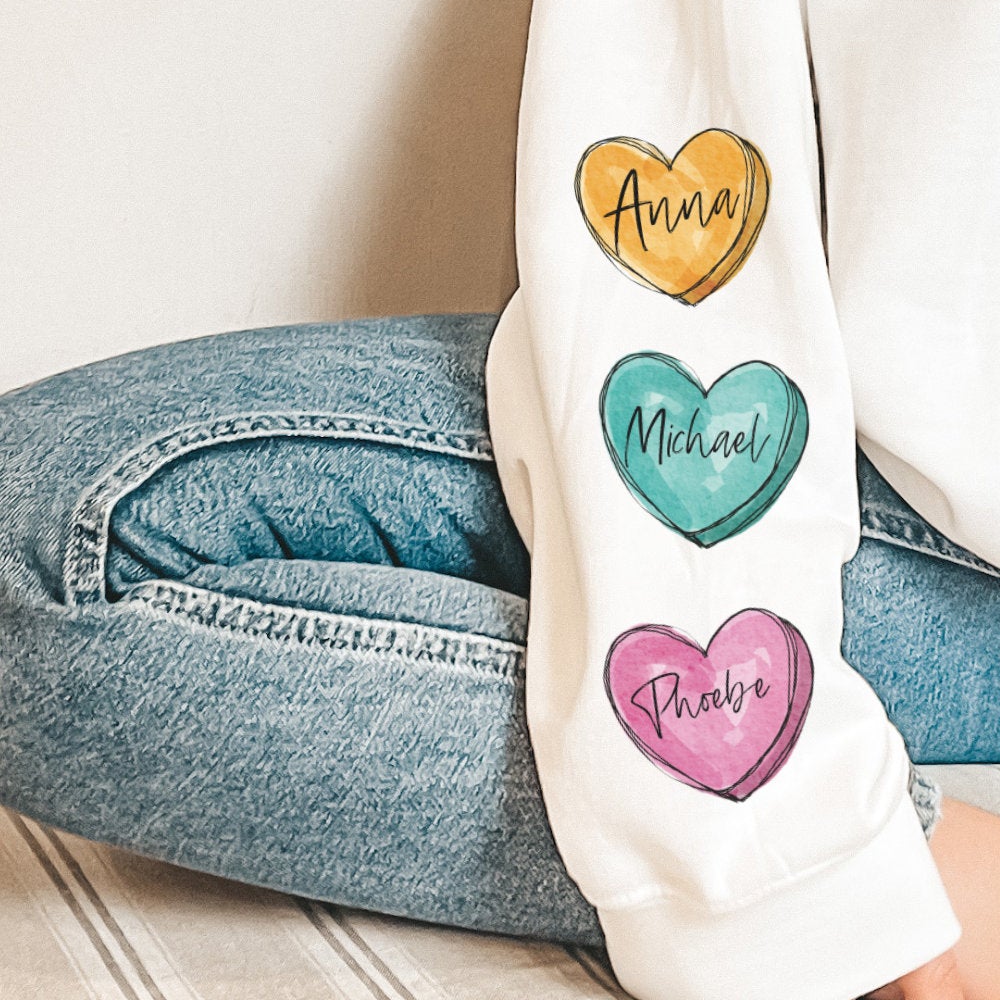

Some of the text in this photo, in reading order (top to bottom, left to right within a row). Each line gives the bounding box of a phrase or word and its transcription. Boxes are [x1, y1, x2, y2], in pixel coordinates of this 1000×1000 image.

[604, 168, 740, 258] Anna
[625, 405, 772, 468] Michael
[630, 669, 771, 739] Phoebe
